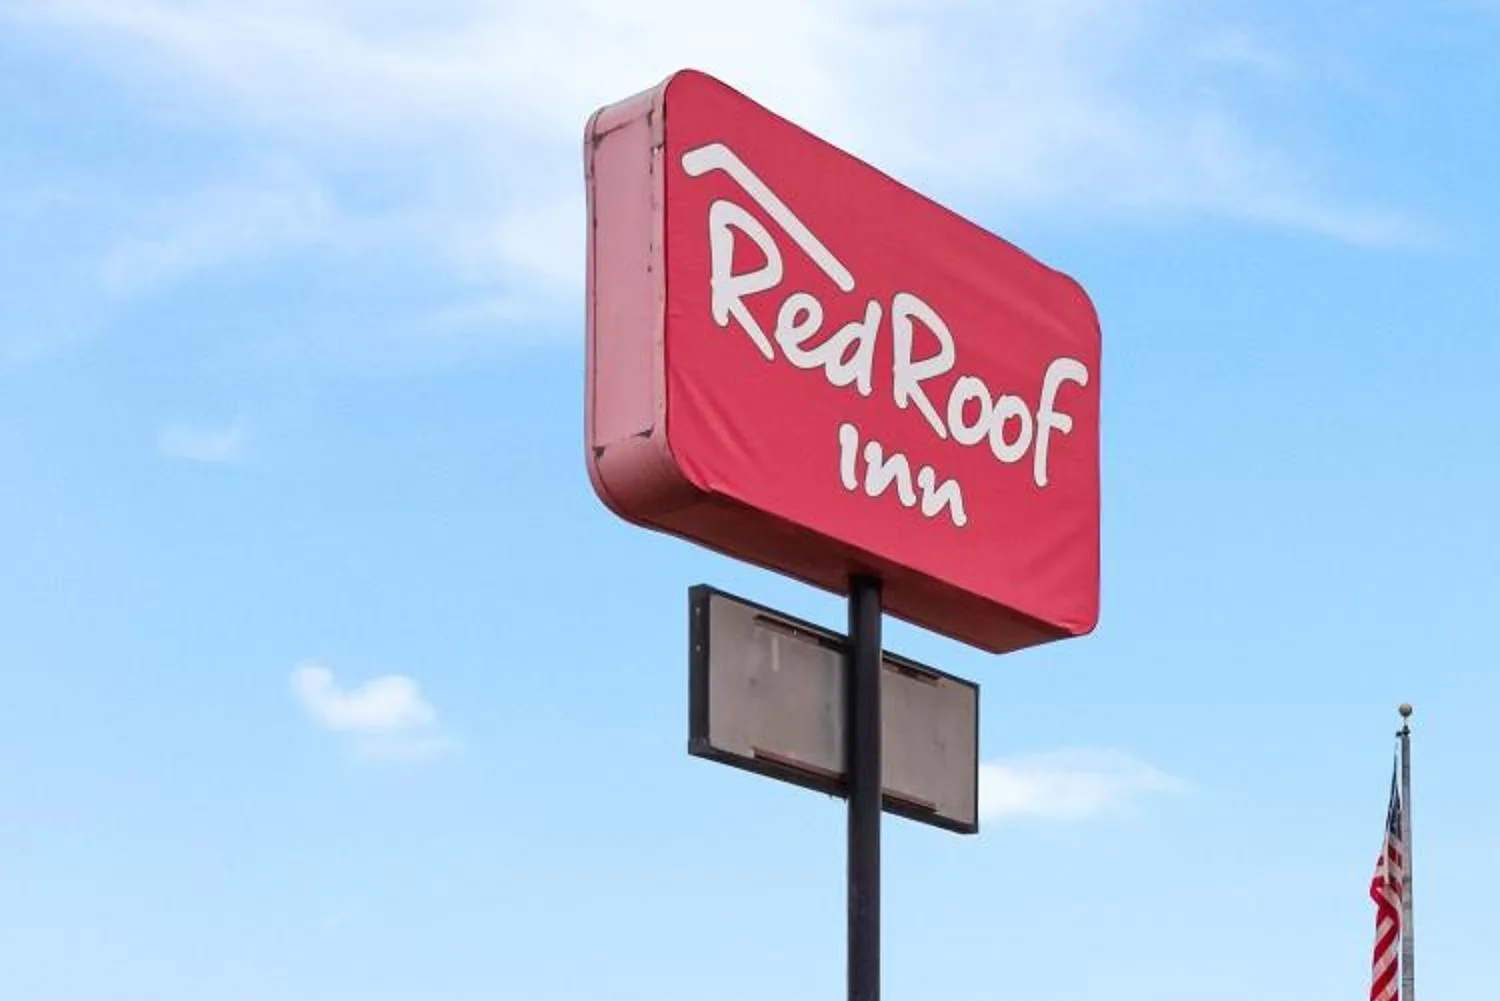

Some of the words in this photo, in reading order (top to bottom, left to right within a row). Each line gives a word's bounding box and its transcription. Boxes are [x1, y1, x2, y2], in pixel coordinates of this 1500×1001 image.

[708, 199, 883, 396] Red
[891, 292, 1088, 488] Roof
[838, 423, 967, 527] Inn
